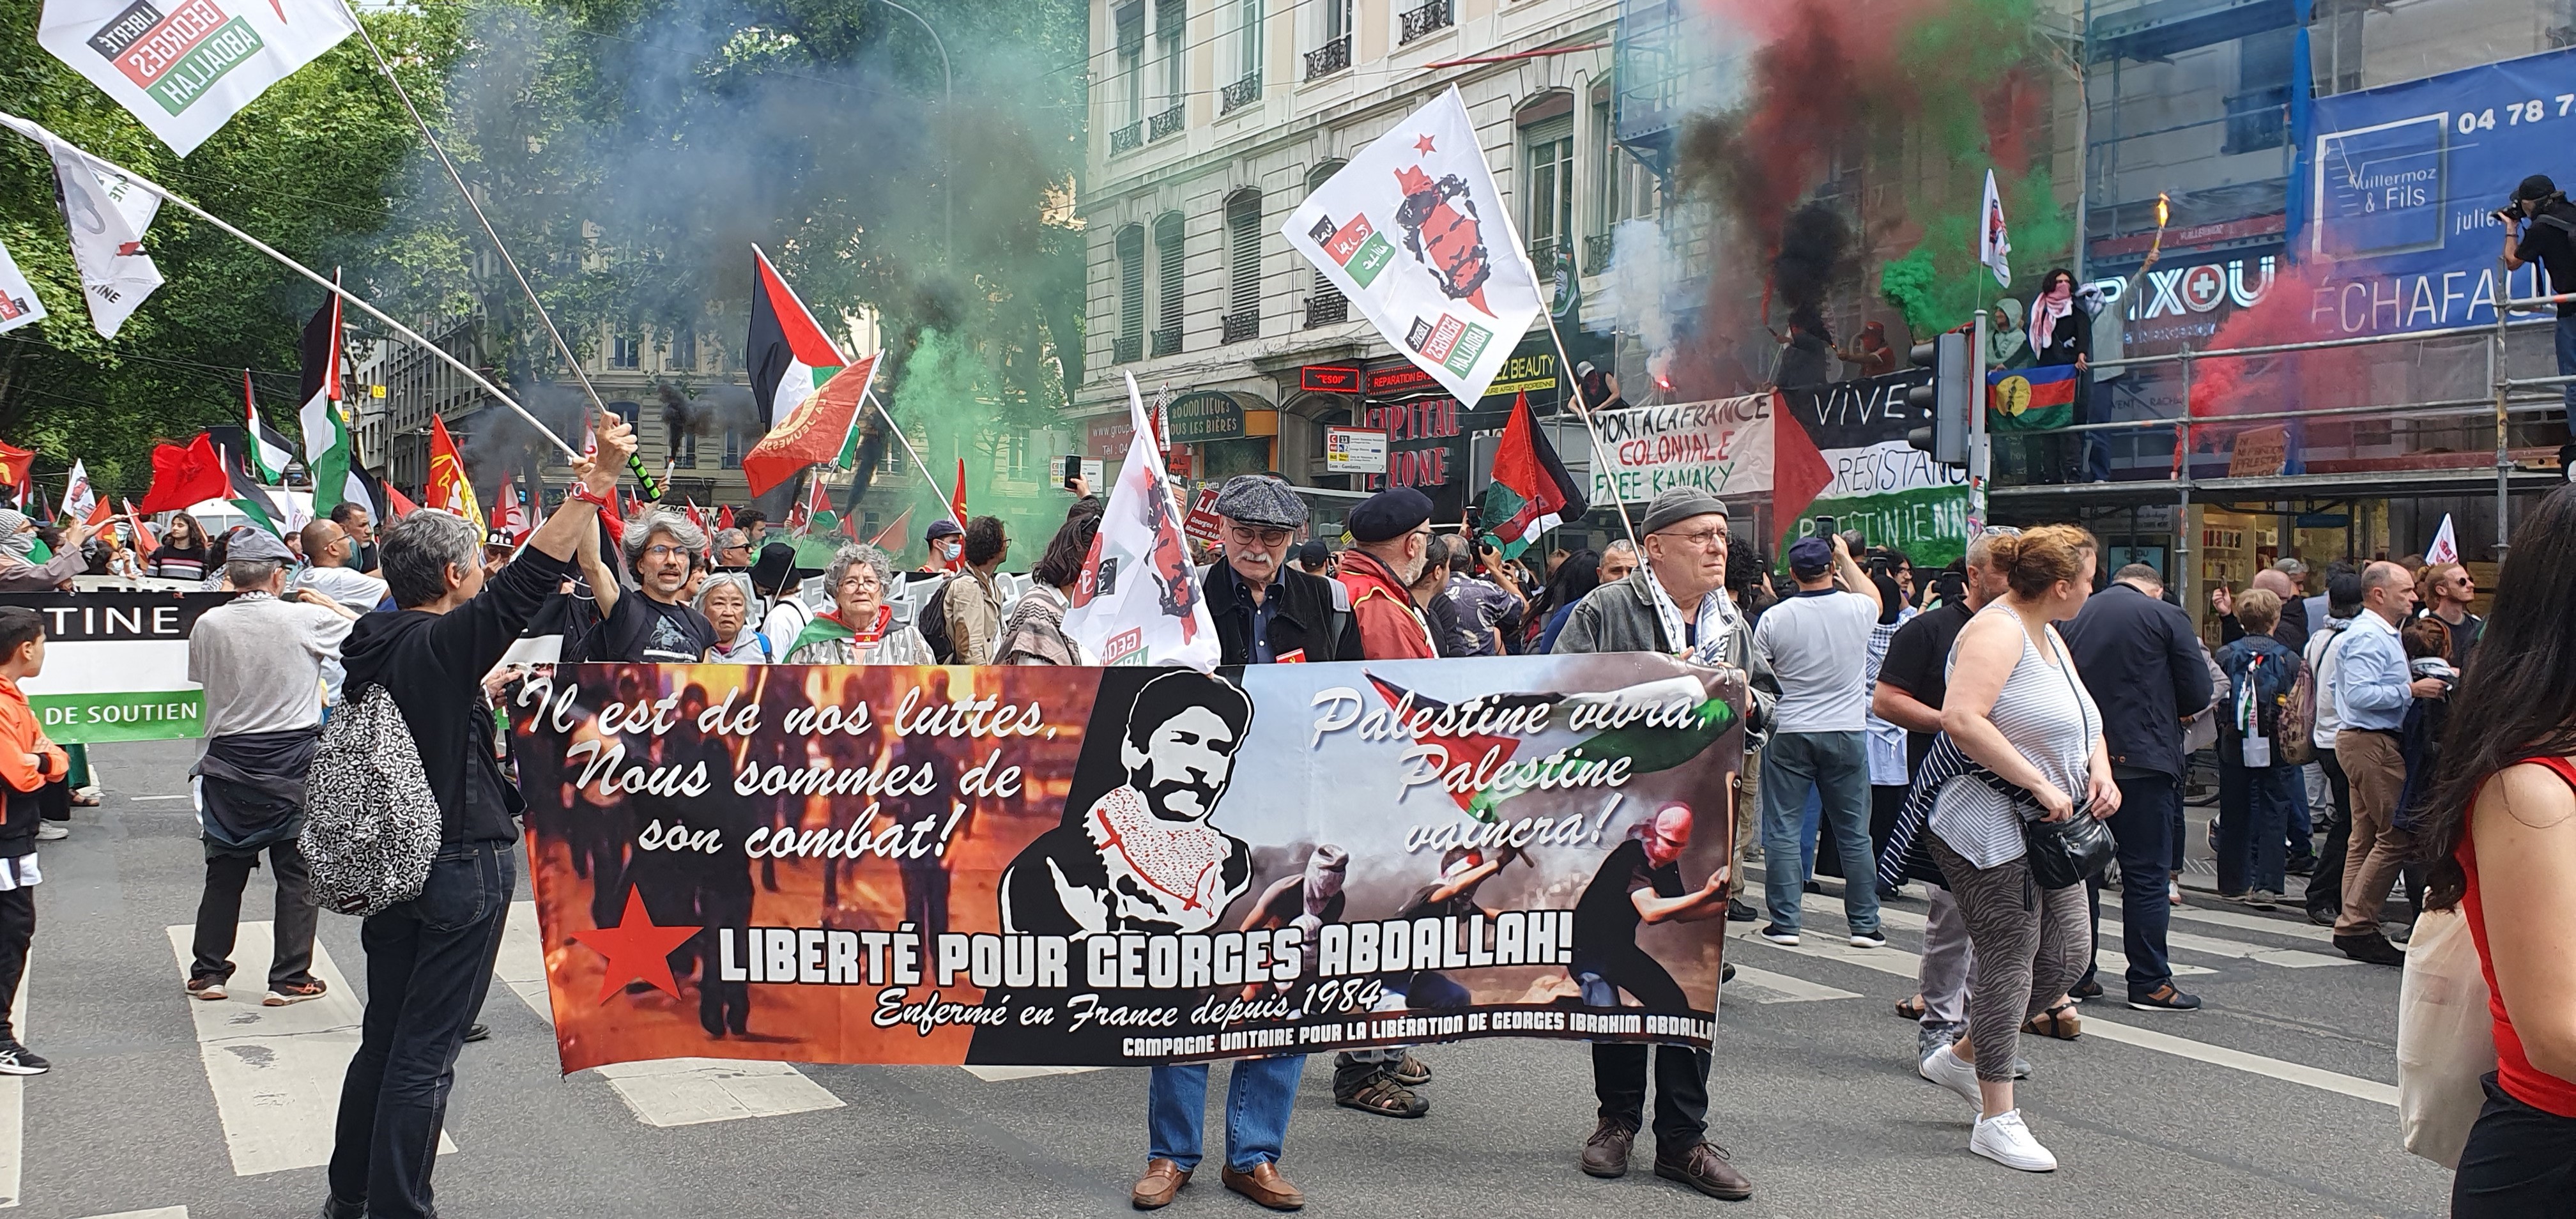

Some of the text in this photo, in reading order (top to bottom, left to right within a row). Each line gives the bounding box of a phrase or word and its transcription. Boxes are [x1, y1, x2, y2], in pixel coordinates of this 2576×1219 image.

[2458, 93, 2576, 135] 04 78 7
[2349, 167, 2437, 190] Vuillermoz
[2365, 186, 2426, 213] & Fils
[2456, 208, 2501, 236] julie
[2312, 262, 2550, 333] ÉCHAFAU
[1374, 373, 1415, 387] REPARATION
[1510, 355, 1555, 379] BEAUTY
[1518, 381, 1553, 390] EROPEENNE
[1170, 416, 1237, 436] OUS LES BIÈRES
[1201, 397, 1230, 414] LIEUES
[1593, 410, 1643, 443] MORT
[1680, 395, 1770, 428] FRANCE
[1368, 447, 1446, 490] ONE
[1619, 431, 1735, 466] COLONIALE
[1653, 462, 1735, 497] KANAKY
[41, 607, 180, 635] TINE
[45, 702, 197, 726] DE SOUTIEN
[516, 677, 1057, 742] Il est de nos luttes,
[1310, 687, 1707, 749] Palestine vivra,
[566, 740, 1023, 799] Nous sommes de
[1397, 744, 1632, 802] Palestine
[638, 802, 961, 860] son combat!
[1404, 793, 1625, 854] vaincra!
[719, 911, 1572, 988] LIBERTÉ POUR GEORGES ABDALLAH!
[874, 978, 1383, 1036] Enfermé en France depuis 1984
[1123, 1012, 1713, 1057] CAMPAGNE UNITAIRE POUR LA LIBÉRATION DE GEORGES IBRAHIM ABDALLA
